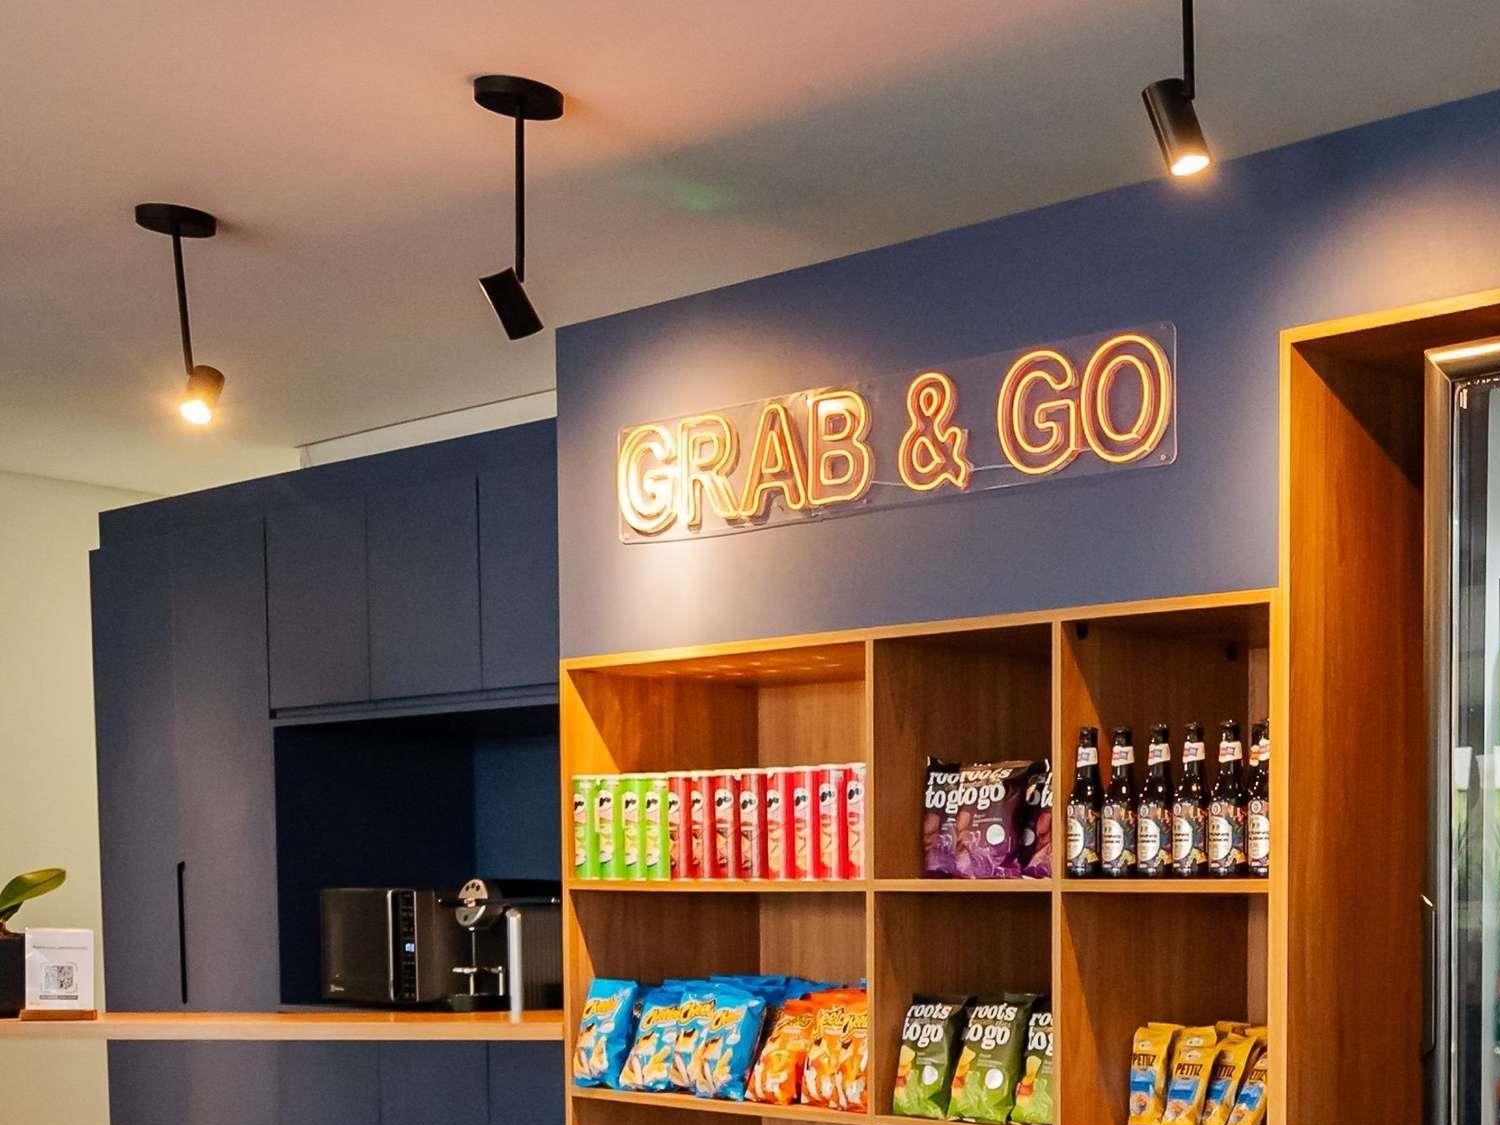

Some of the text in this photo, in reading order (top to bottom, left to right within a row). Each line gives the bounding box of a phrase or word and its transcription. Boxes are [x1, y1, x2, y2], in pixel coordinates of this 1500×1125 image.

[616, 333, 1172, 536] GRAB & GO
[907, 1002, 952, 1019] roots
[972, 1002, 1018, 1021] roots
